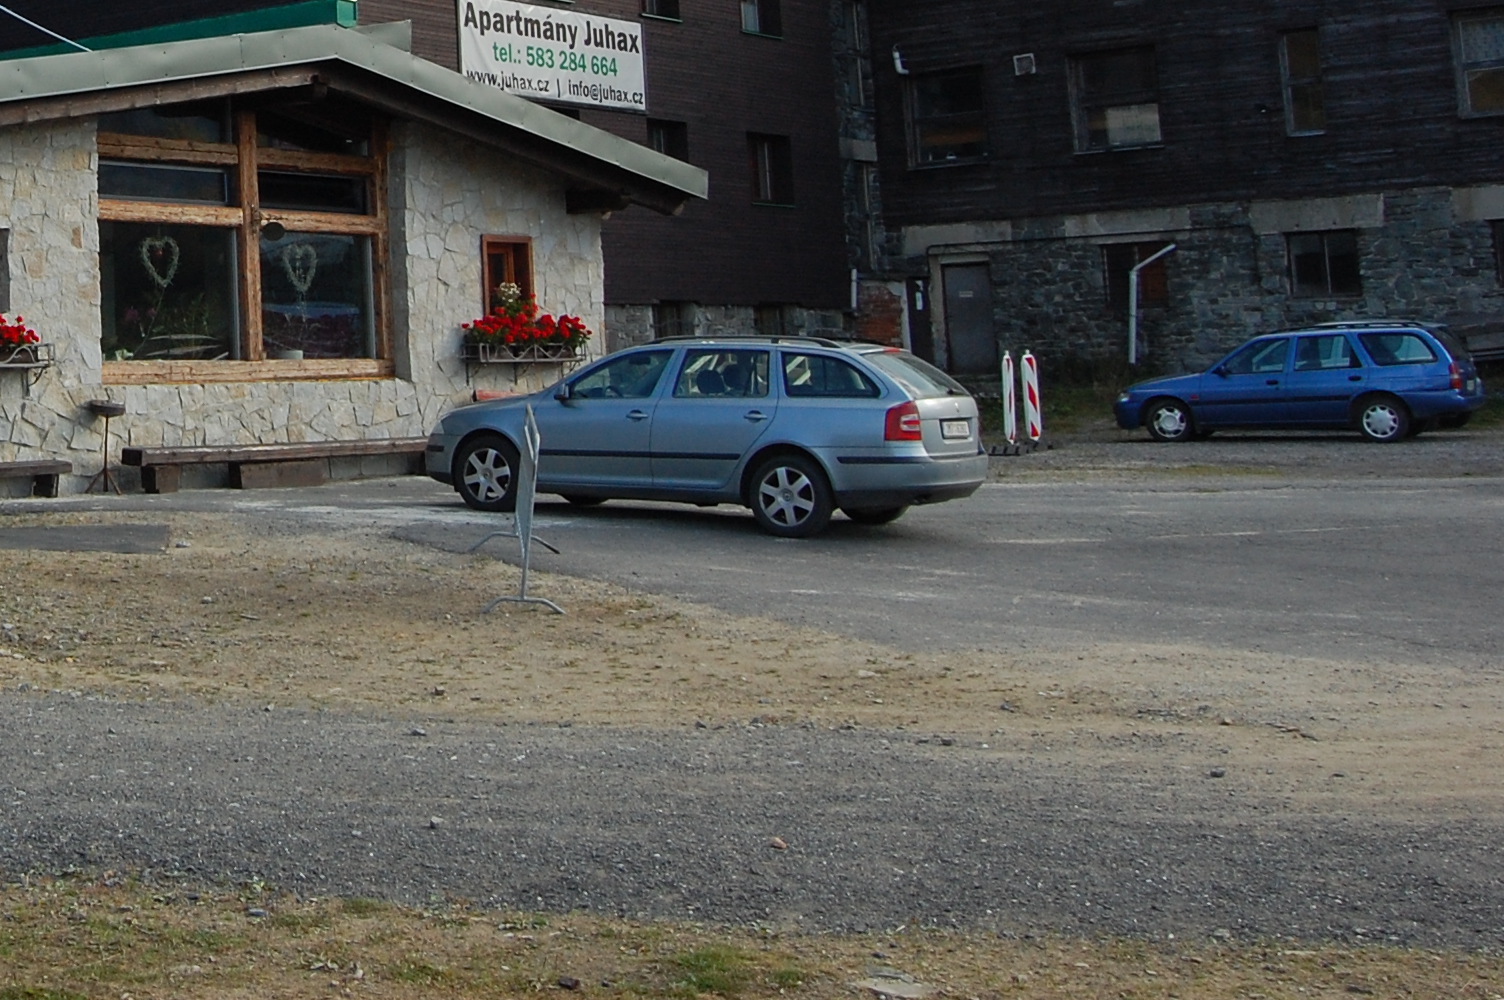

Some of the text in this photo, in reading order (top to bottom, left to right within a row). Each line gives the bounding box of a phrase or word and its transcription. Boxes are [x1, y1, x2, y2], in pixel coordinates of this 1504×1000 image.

[464, 2, 640, 54] Apartmány Juhax
[492, 42, 618, 77] tel.: 583 284 664
[466, 70, 550, 92] www.juhax.cz
[568, 79, 644, 105] info@juhax.cz
